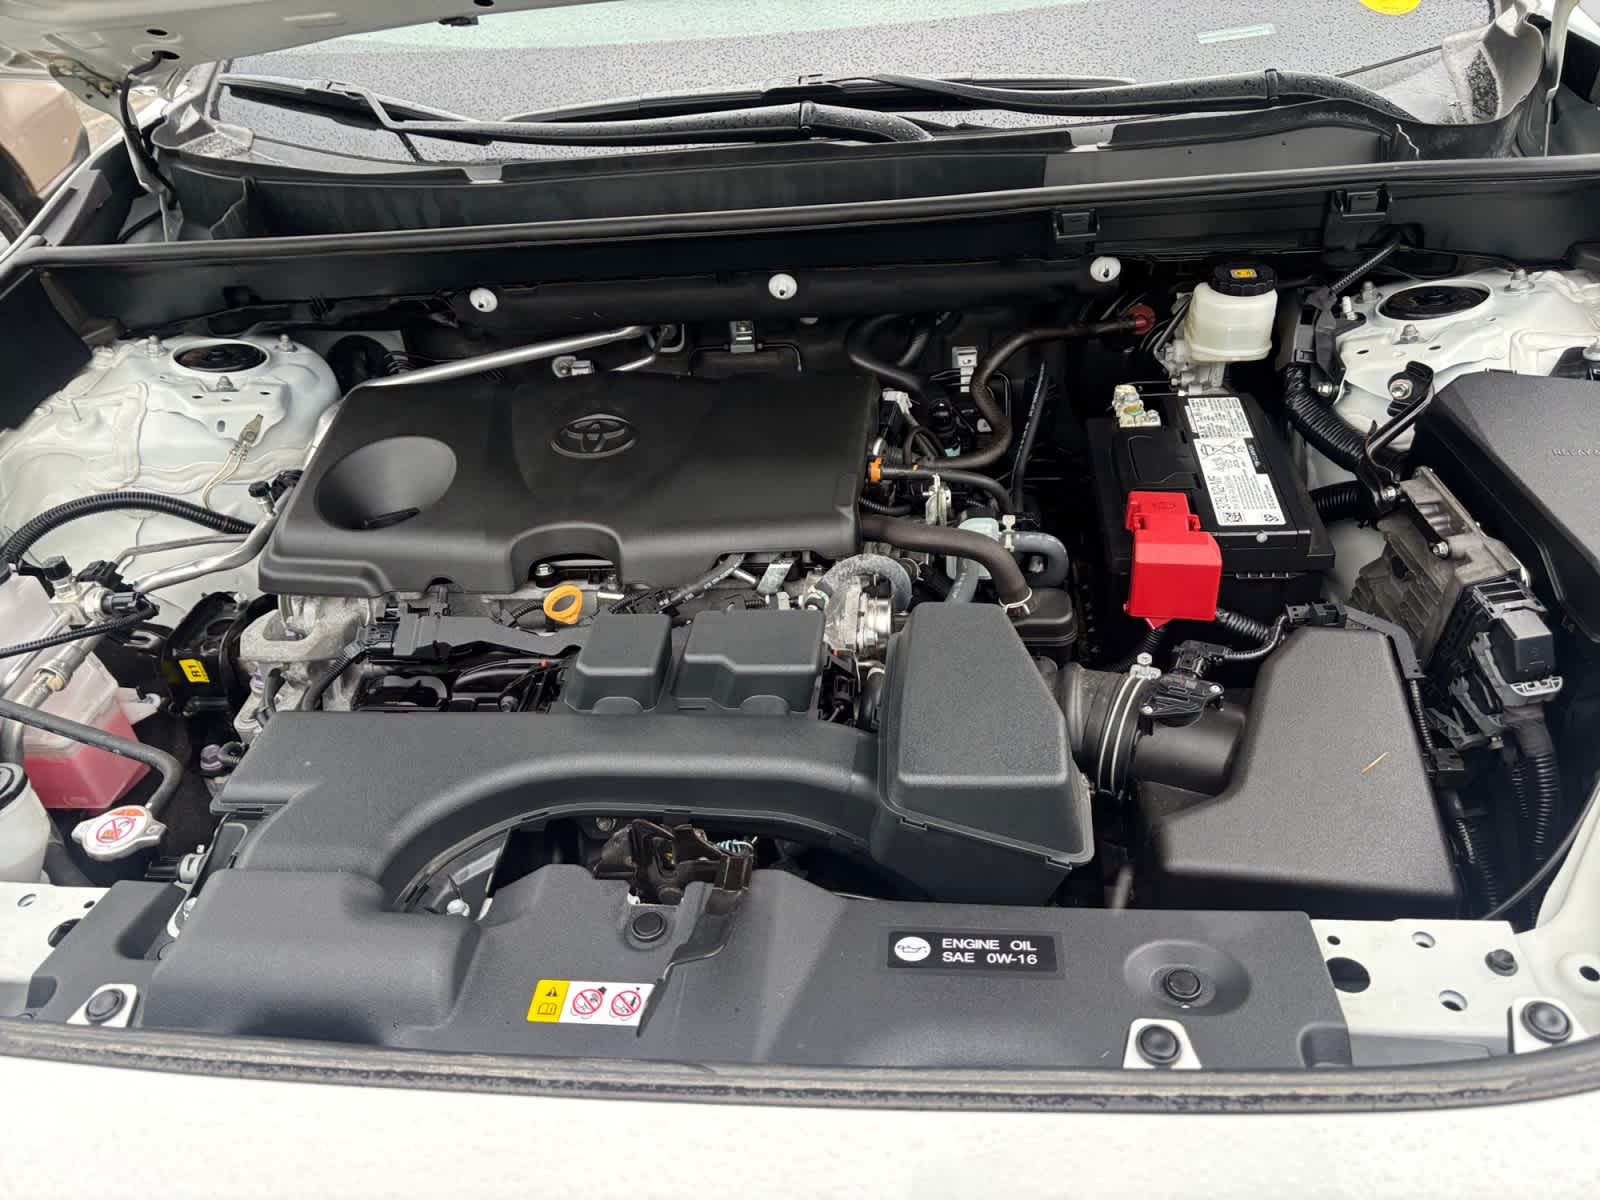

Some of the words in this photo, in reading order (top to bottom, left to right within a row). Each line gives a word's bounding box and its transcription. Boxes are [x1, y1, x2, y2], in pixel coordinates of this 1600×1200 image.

[941, 938, 1000, 950] ENGINE
[1009, 940, 1037, 951] OIL
[941, 951, 975, 963] SAE
[986, 953, 1038, 965] 0W-16
